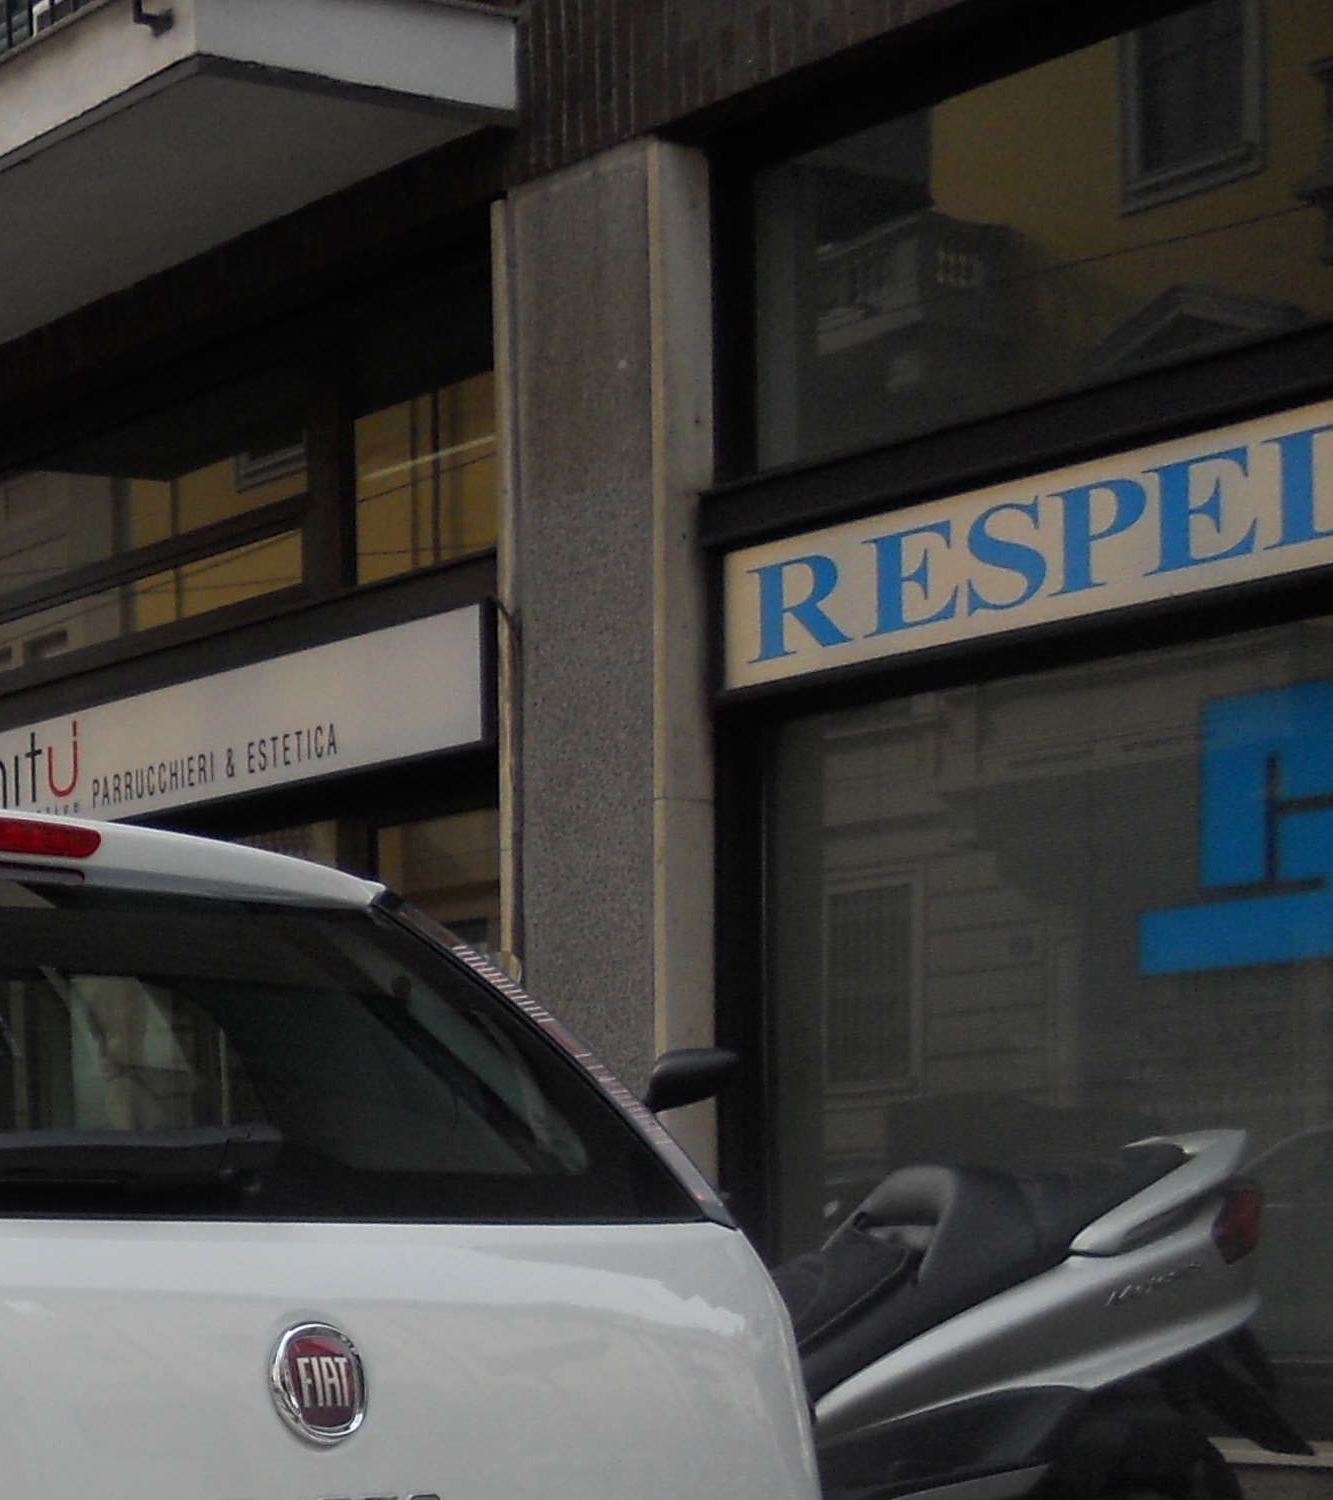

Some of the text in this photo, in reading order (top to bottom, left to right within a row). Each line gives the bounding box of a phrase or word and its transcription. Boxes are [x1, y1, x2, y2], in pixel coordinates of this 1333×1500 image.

[92, 723, 338, 808] PARRUCCHIERI & ESTETICA
[296, 1356, 350, 1408] FIAT
